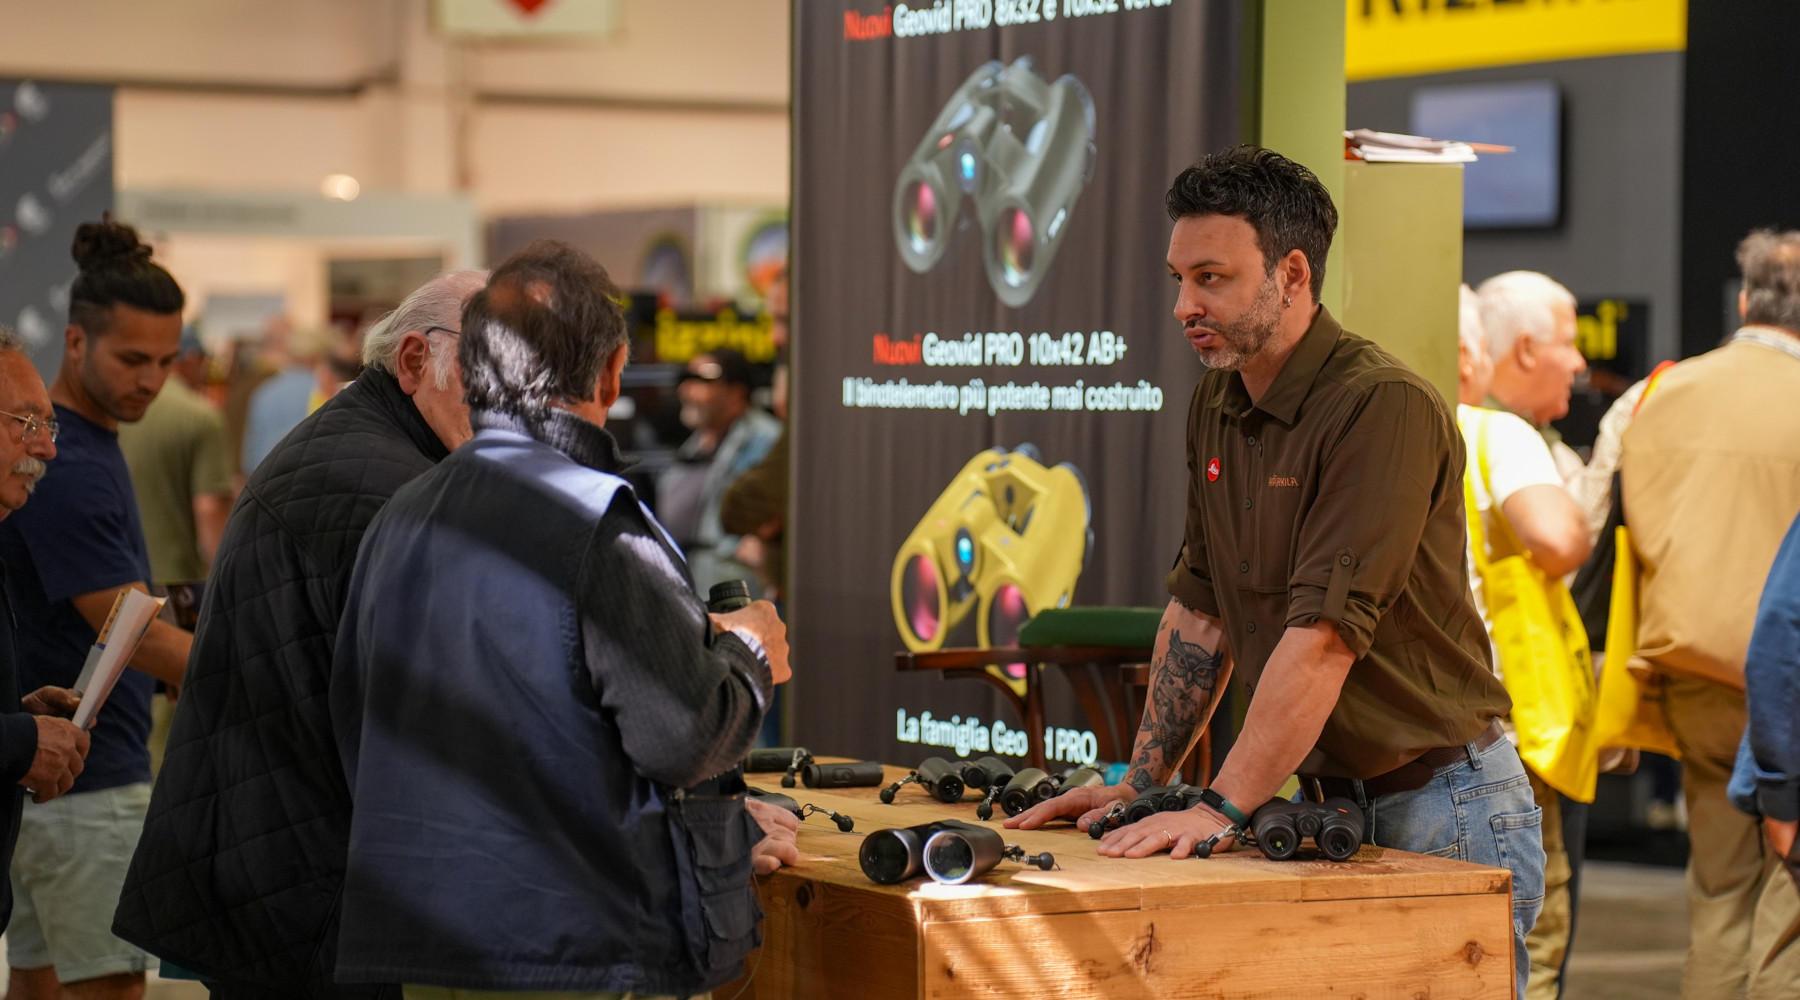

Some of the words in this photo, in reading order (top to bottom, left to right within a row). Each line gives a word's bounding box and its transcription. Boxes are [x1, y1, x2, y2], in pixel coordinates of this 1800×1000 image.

[844, 6, 892, 40] Nuovi
[893, 0, 951, 38] Geovid
[953, 0, 992, 31] PRO
[873, 333, 921, 365] Nuovi
[922, 332, 982, 366] Geovid
[984, 332, 1024, 366] PRO
[1028, 332, 1084, 366] 10x42
[1086, 331, 1127, 366] AB+
[843, 377, 856, 407] Il
[960, 378, 987, 416] più
[988, 381, 1050, 416] potente
[1051, 378, 1083, 410] mai
[1085, 379, 1163, 411] costruito
[897, 708, 919, 743] La
[920, 710, 990, 757] famiglia
[1055, 727, 1098, 765] PRO
